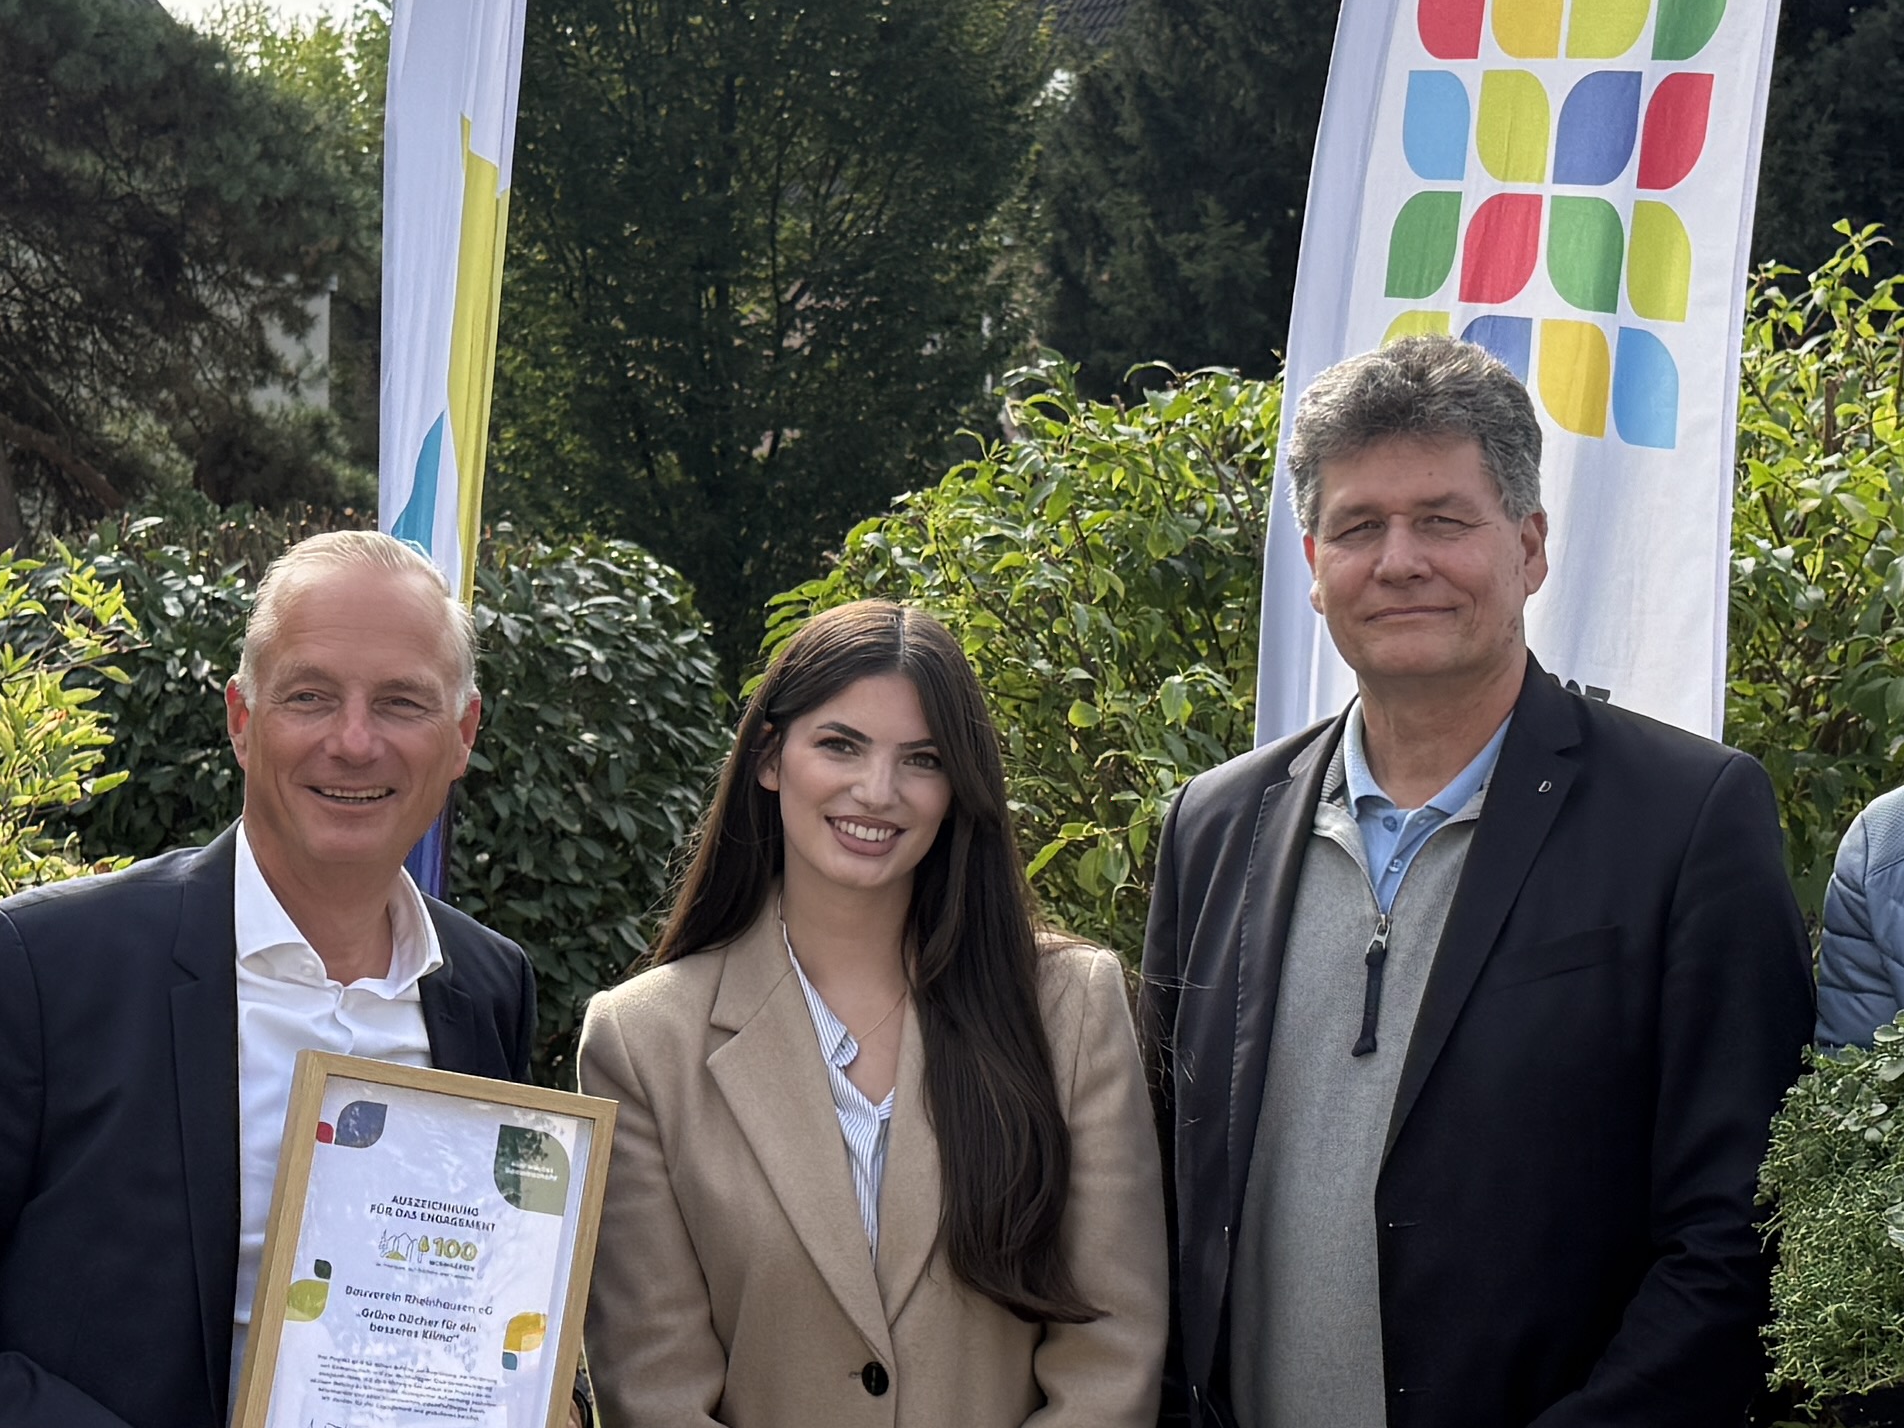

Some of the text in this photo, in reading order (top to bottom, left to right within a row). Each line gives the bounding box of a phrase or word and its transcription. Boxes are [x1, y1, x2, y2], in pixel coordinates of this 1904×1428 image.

[369, 1203, 496, 1233] FÜR DAS ENGAGEMENT
[432, 1236, 479, 1262] 100
[345, 1284, 402, 1302] Bauverein
[404, 1293, 476, 1314] Rheinhausen
[398, 1312, 439, 1329] Dächer
[441, 1318, 457, 1332] für
